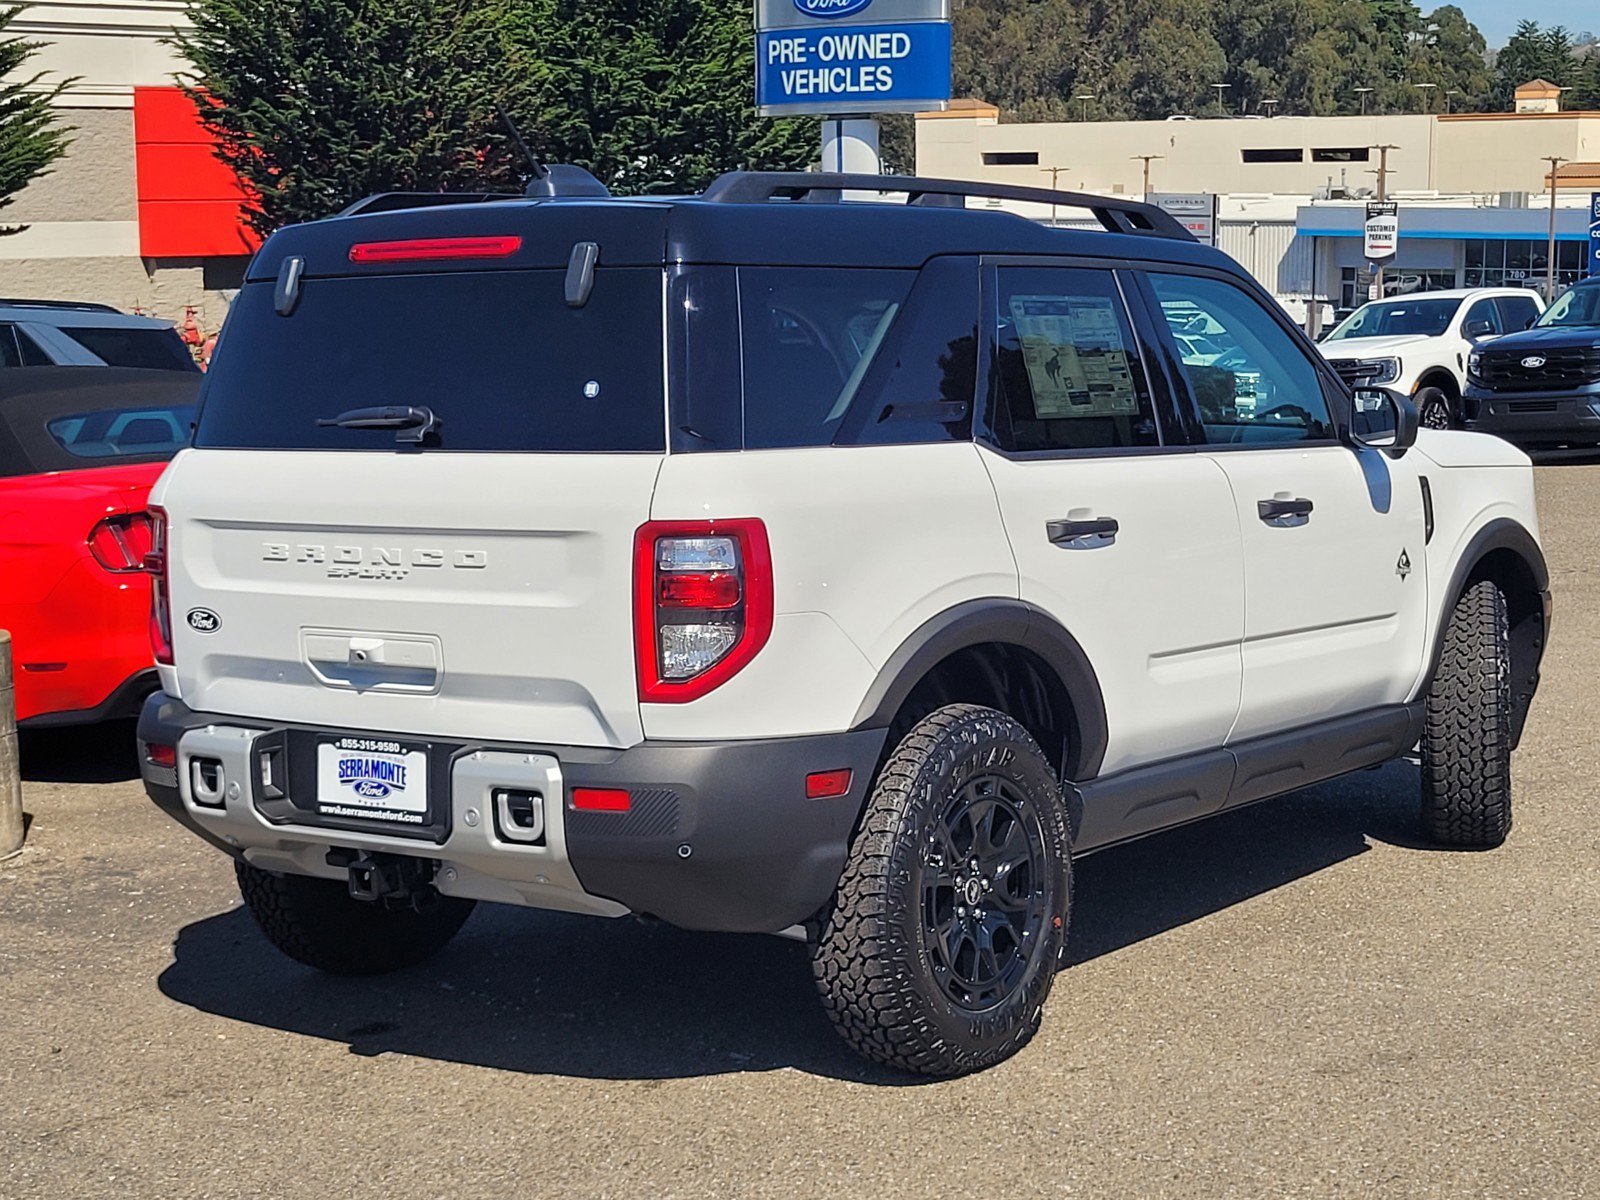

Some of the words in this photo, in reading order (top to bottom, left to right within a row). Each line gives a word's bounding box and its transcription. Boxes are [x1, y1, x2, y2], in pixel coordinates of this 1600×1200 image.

[768, 33, 911, 64] PRE-OWNED
[781, 66, 893, 95] VEHICLES
[1368, 233, 1392, 241] PARKING
[1510, 270, 1526, 279] 780
[262, 542, 487, 569] BRONCO
[326, 566, 409, 580] SPORT
[190, 610, 216, 631] Ford
[341, 738, 400, 753] 855-315-9580
[338, 758, 407, 787] SERRAMONTE
[357, 781, 387, 797] Ford
[320, 804, 423, 823] www.serramonteford.com
